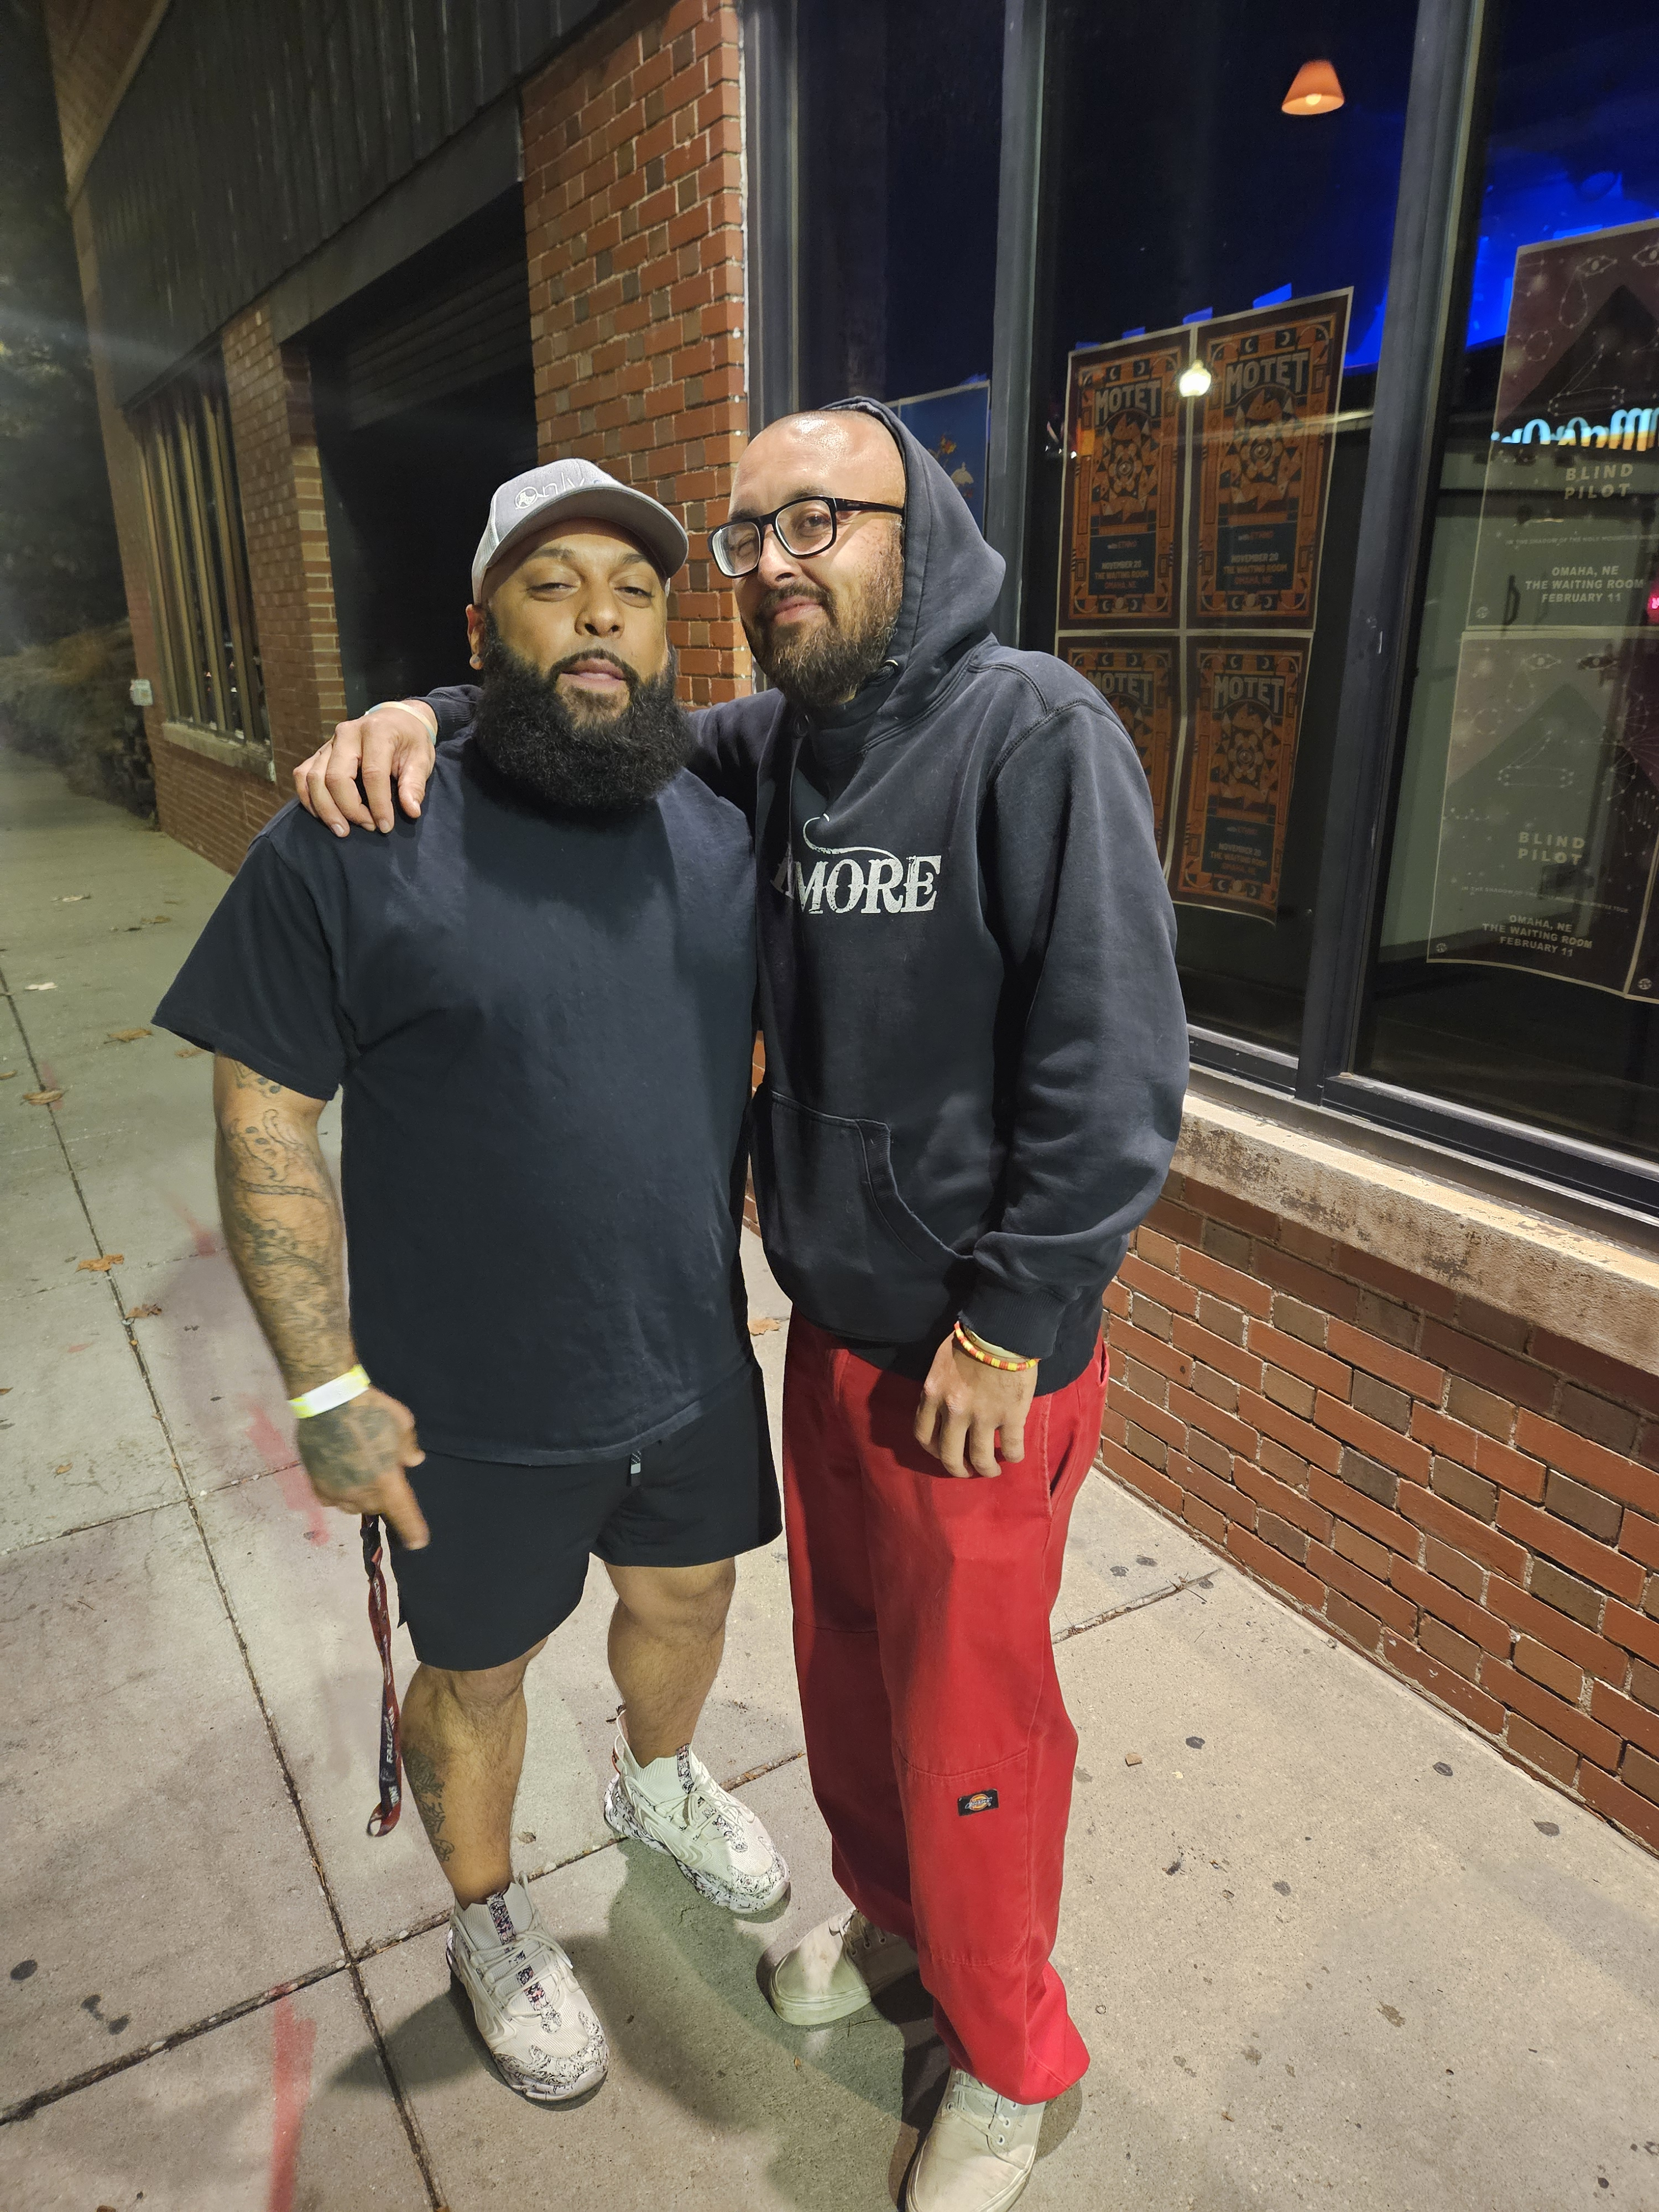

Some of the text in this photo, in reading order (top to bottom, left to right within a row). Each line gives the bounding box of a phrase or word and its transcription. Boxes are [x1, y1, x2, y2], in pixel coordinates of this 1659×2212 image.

[1225, 352, 1309, 405] MOTET
[1095, 379, 1161, 425] MOTET
[1565, 463, 1634, 482] BLIND
[1564, 483, 1631, 500] PILOT
[1551, 565, 1620, 577] OMAHA, NE
[1525, 579, 1644, 591] THE WAITING ROOM
[1541, 592, 1622, 603] FEBRUARY 11
[1214, 675, 1285, 713] MOTET
[1517, 832, 1585, 849] BLIND
[1517, 848, 1583, 865] PILOT
[1509, 914, 1572, 932] OMAHA, NE
[1481, 922, 1593, 950] THE WAITING ROOM
[1500, 937, 1574, 957] FEBRUARY 11
